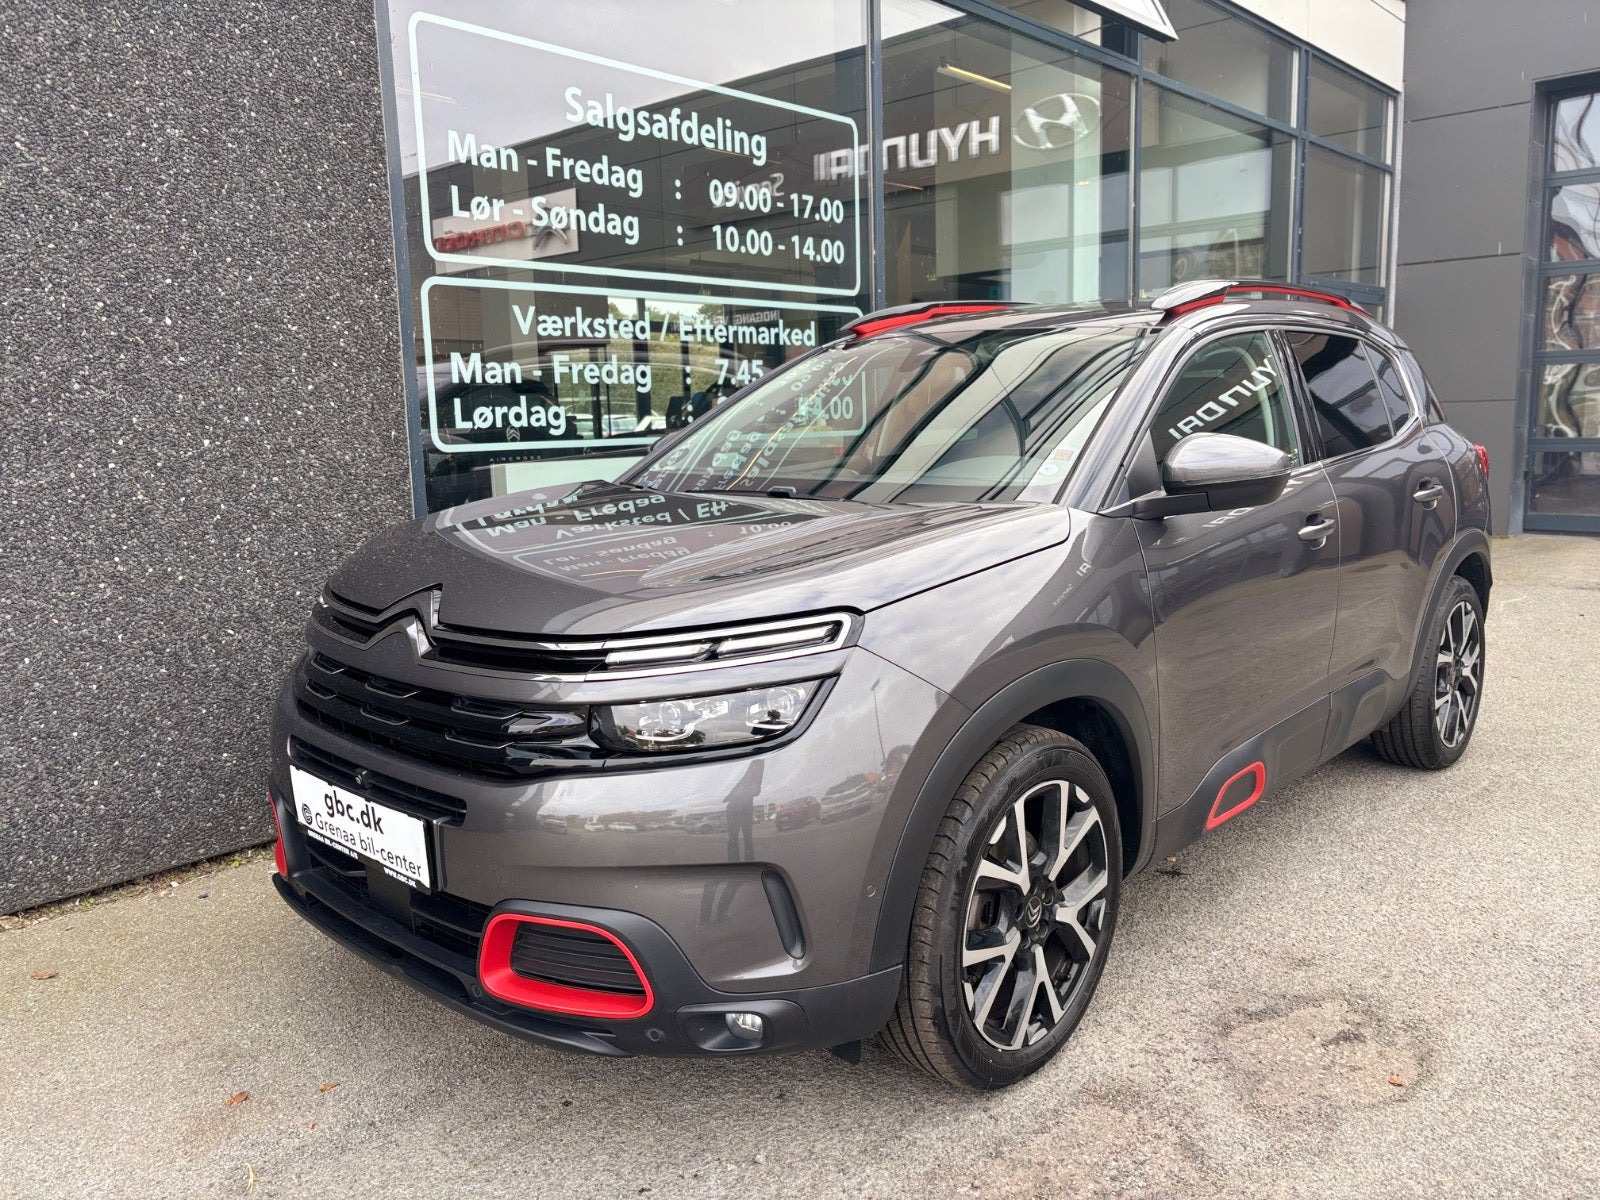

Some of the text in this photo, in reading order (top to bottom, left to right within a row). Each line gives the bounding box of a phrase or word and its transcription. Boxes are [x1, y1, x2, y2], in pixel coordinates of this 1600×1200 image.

[564, 86, 767, 166] Salgsafdeling
[447, 130, 519, 172] Man
[545, 147, 644, 198] Fredag
[709, 179, 772, 213] 09.00
[790, 193, 844, 224] 17.00
[450, 185, 505, 221] Lør
[531, 196, 640, 245] Søndag
[712, 225, 773, 256] 10.00
[791, 235, 845, 265] 14.00
[511, 305, 651, 340] Værksted
[679, 315, 816, 347] Eftermarked
[450, 352, 523, 384] Man
[552, 354, 652, 393] Fredag
[714, 359, 765, 385] 7.45
[453, 395, 567, 436] Lørdag
[323, 790, 385, 835] gbc.dk
[314, 812, 357, 846] Grenaa
[358, 832, 422, 877] bil-center
